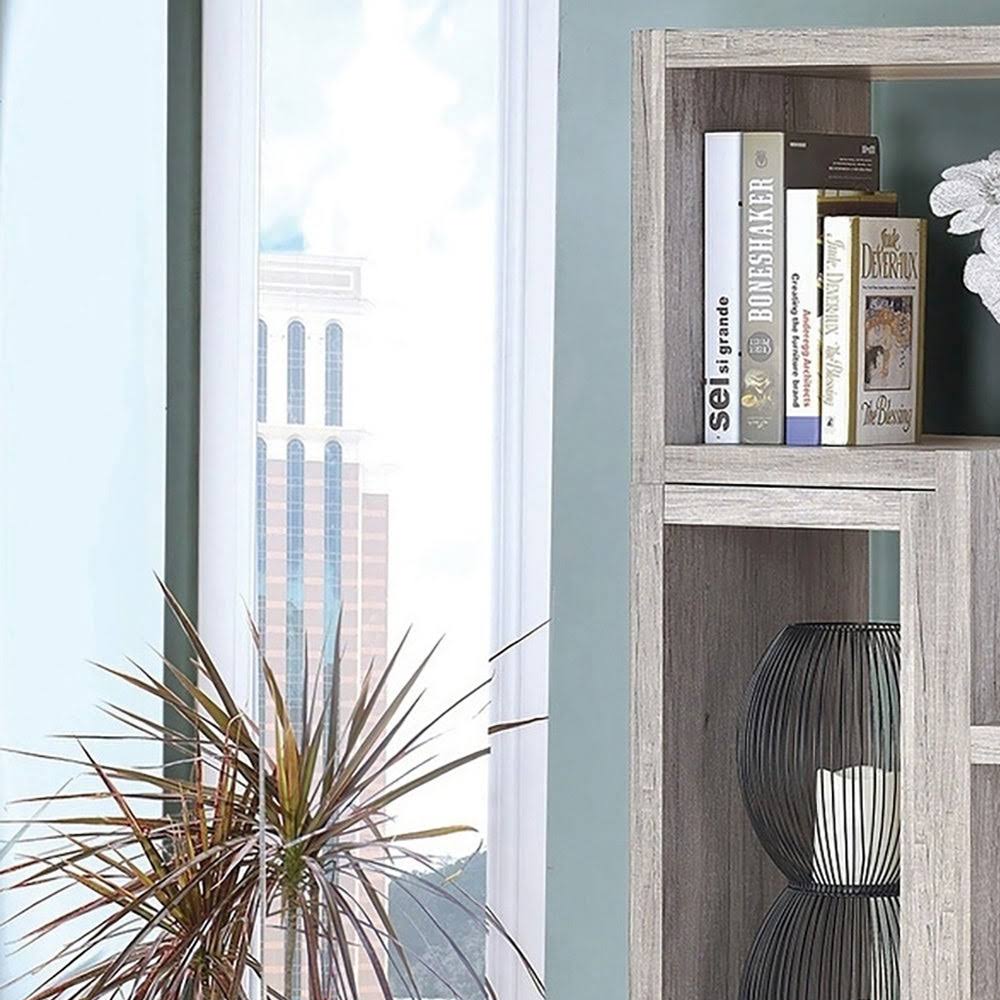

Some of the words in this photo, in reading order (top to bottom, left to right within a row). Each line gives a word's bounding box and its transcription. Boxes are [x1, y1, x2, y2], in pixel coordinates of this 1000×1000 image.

[748, 177, 774, 323] BONESHAKER
[790, 272, 801, 316] Creating
[716, 296, 732, 355] grande
[792, 317, 800, 333] the
[715, 360, 729, 374] si
[791, 335, 801, 378] furniture
[709, 378, 730, 432] sel
[792, 379, 801, 408] brand
[803, 358, 812, 408] Architects
